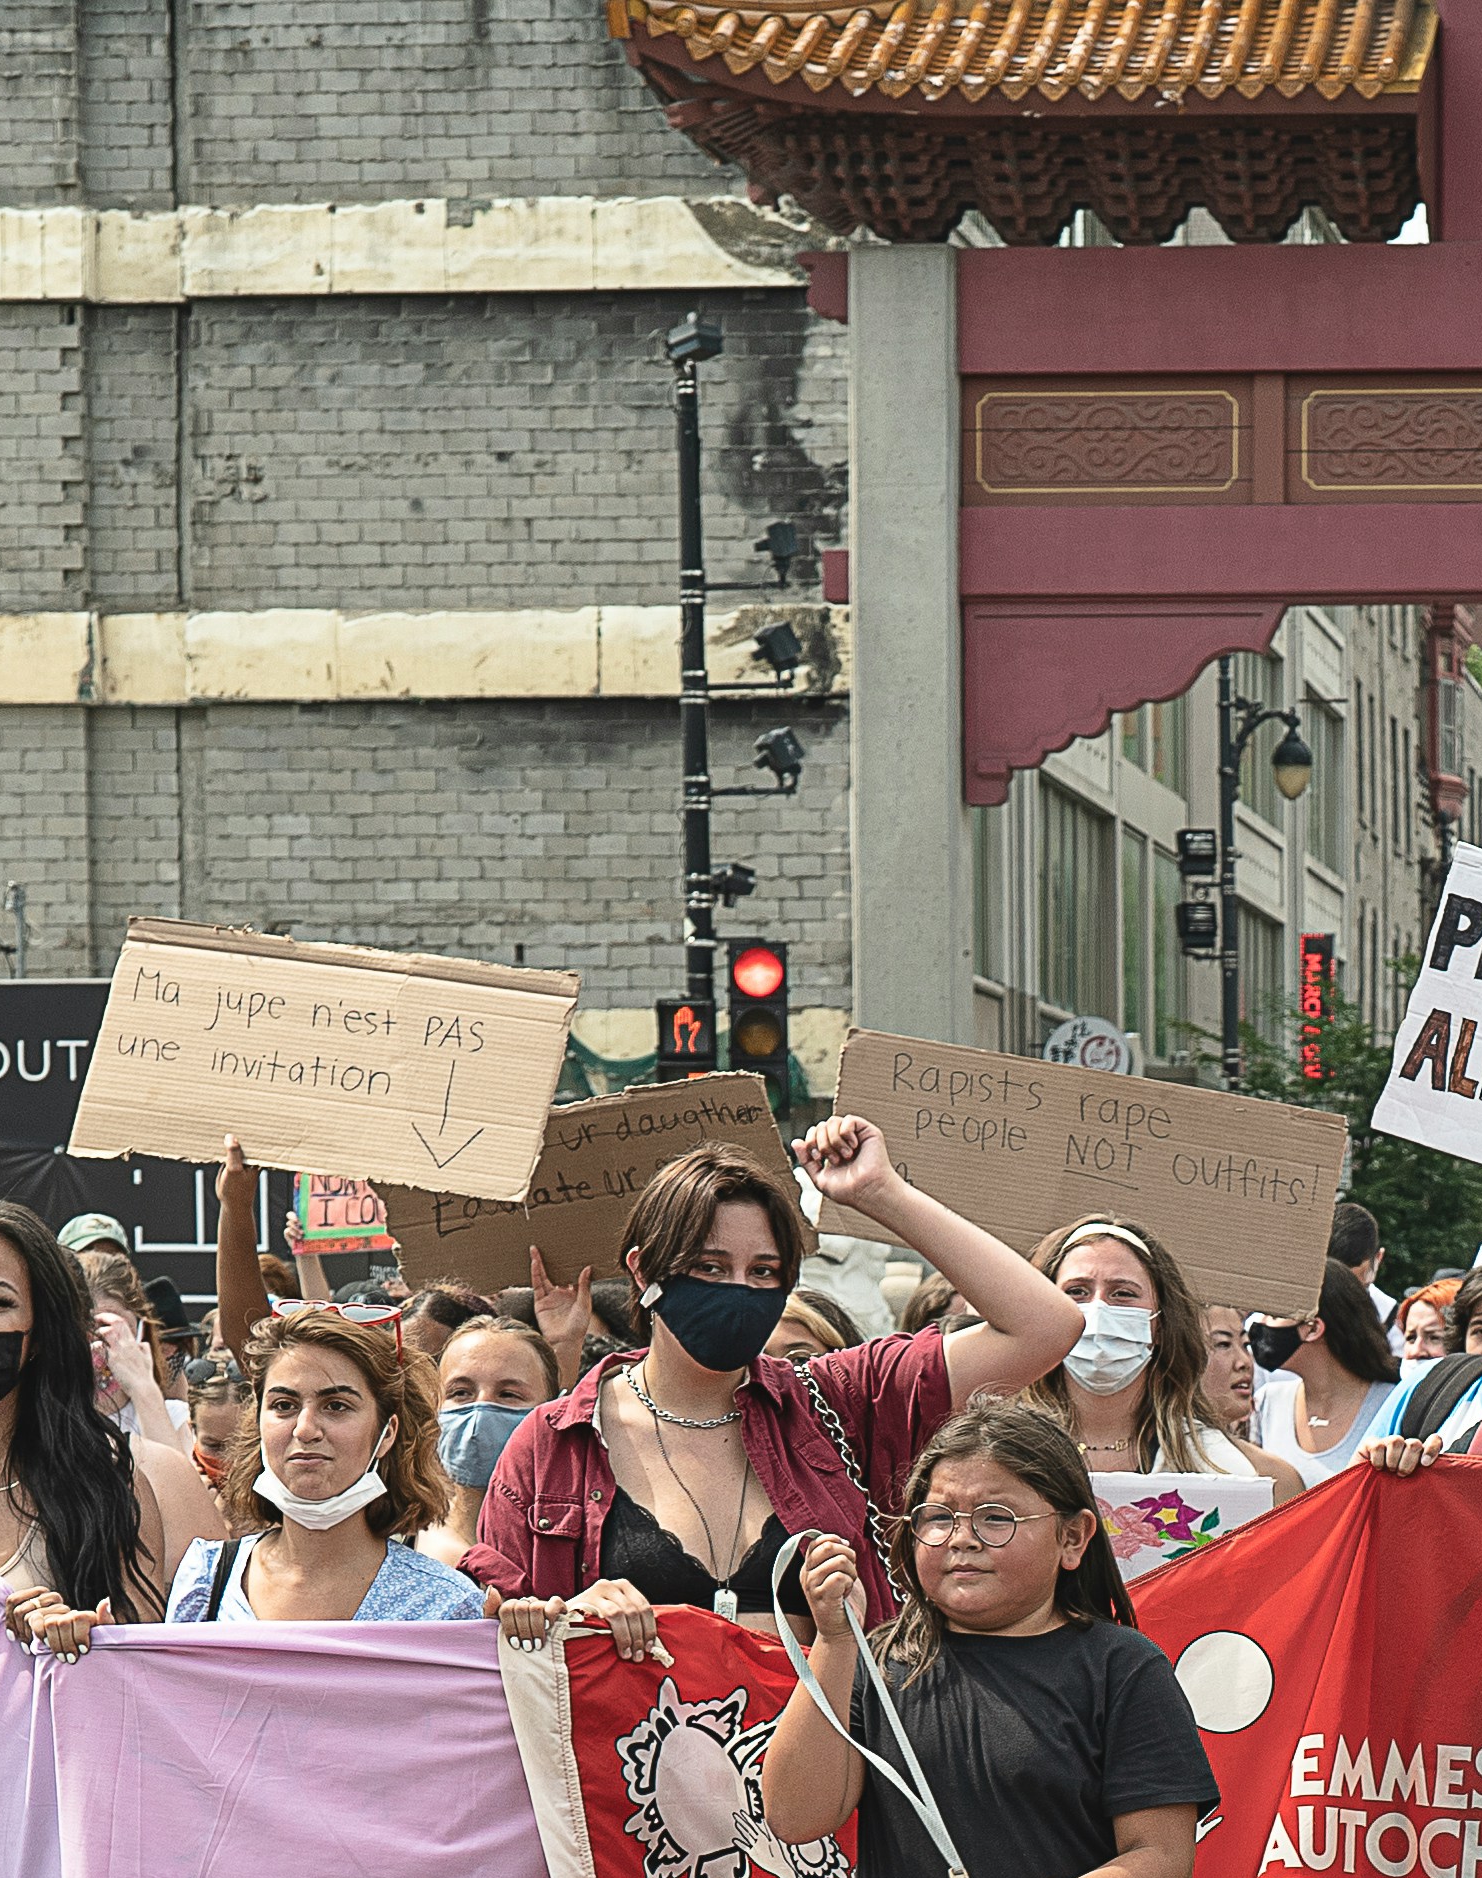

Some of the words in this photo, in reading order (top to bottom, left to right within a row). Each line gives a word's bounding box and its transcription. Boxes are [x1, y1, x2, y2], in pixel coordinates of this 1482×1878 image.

[132, 966, 181, 1007] Ma
[205, 985, 287, 1030] jupe
[312, 1000, 397, 1036] n'est
[424, 1016, 485, 1053] PAS
[118, 1033, 181, 1062] une
[212, 1047, 392, 1095] invitation
[892, 1052, 1045, 1110] Rapists
[1079, 1092, 1171, 1140] rape
[916, 1108, 1027, 1152] people
[1066, 1134, 1142, 1172] NOT
[1172, 1153, 1319, 1211] outfits!
